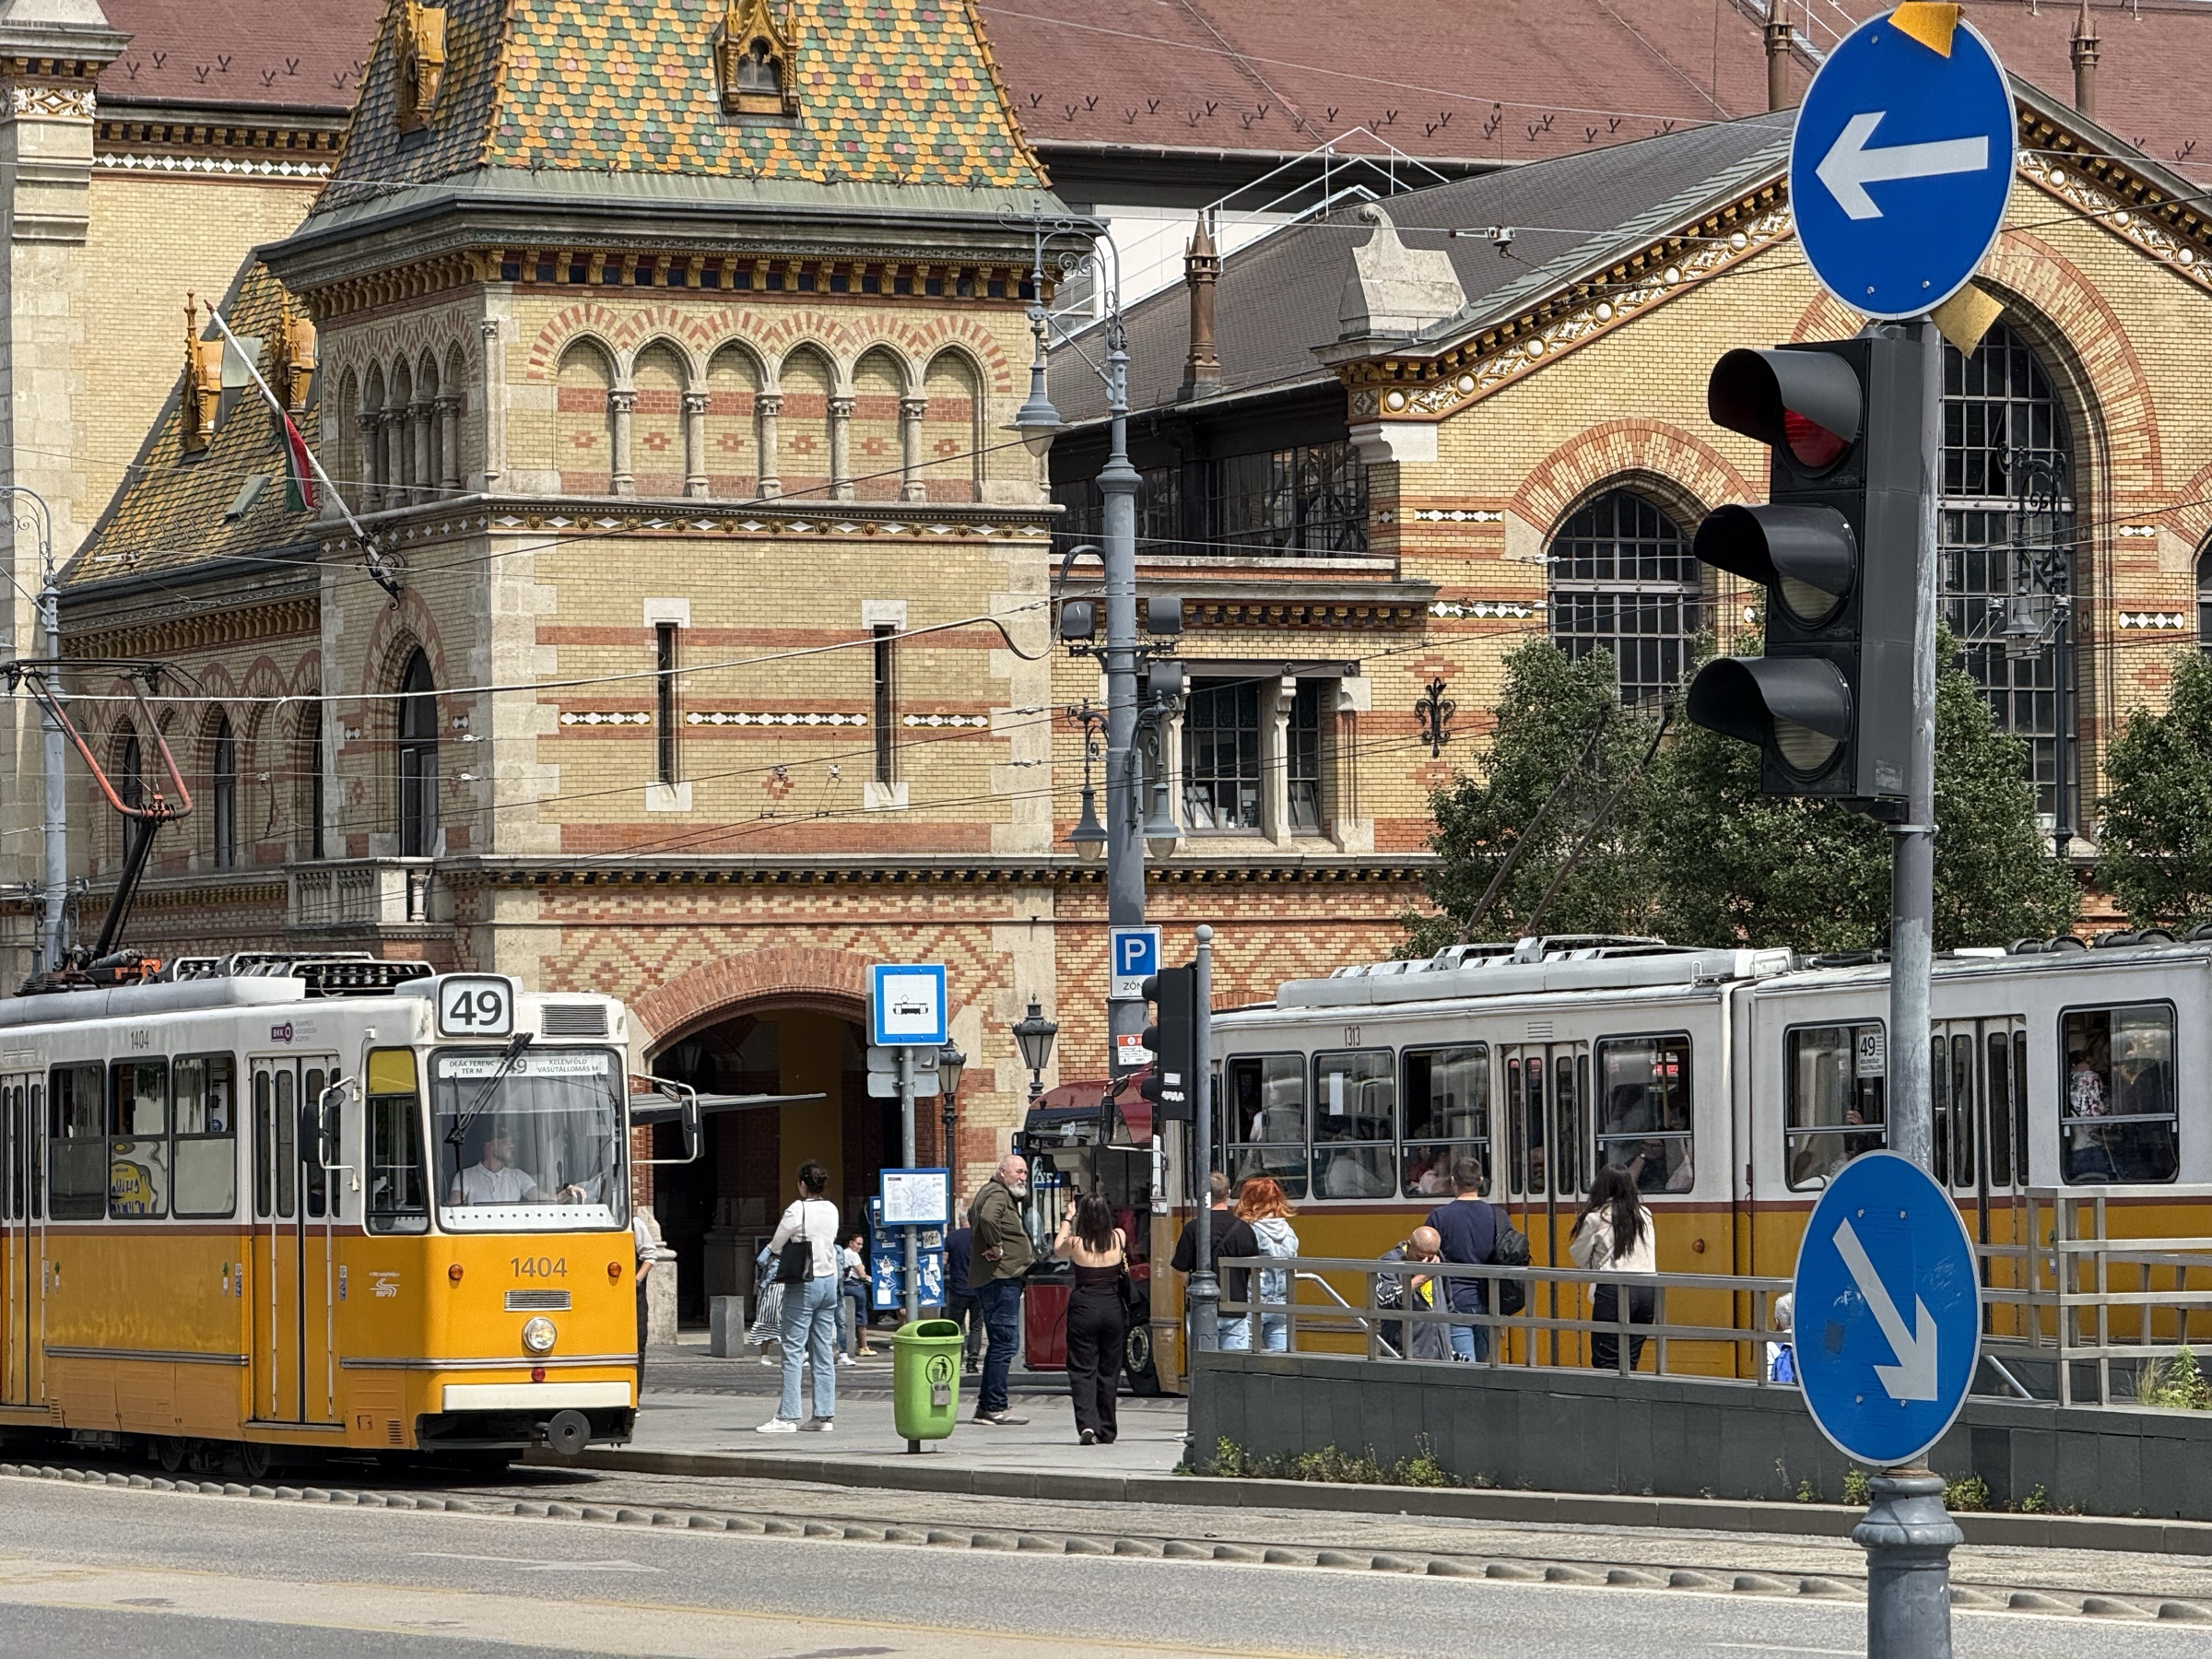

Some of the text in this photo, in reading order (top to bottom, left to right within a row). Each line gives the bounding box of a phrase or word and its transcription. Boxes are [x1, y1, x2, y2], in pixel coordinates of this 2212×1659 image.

[1124, 938, 1147, 971] P
[1124, 981, 1143, 991] ZÓN
[449, 990, 502, 1026] 49
[130, 1030, 149, 1050] 1404
[1344, 1026, 1360, 1048] 1313
[1860, 1036, 1876, 1056] 49
[511, 1256, 568, 1277] 1404
